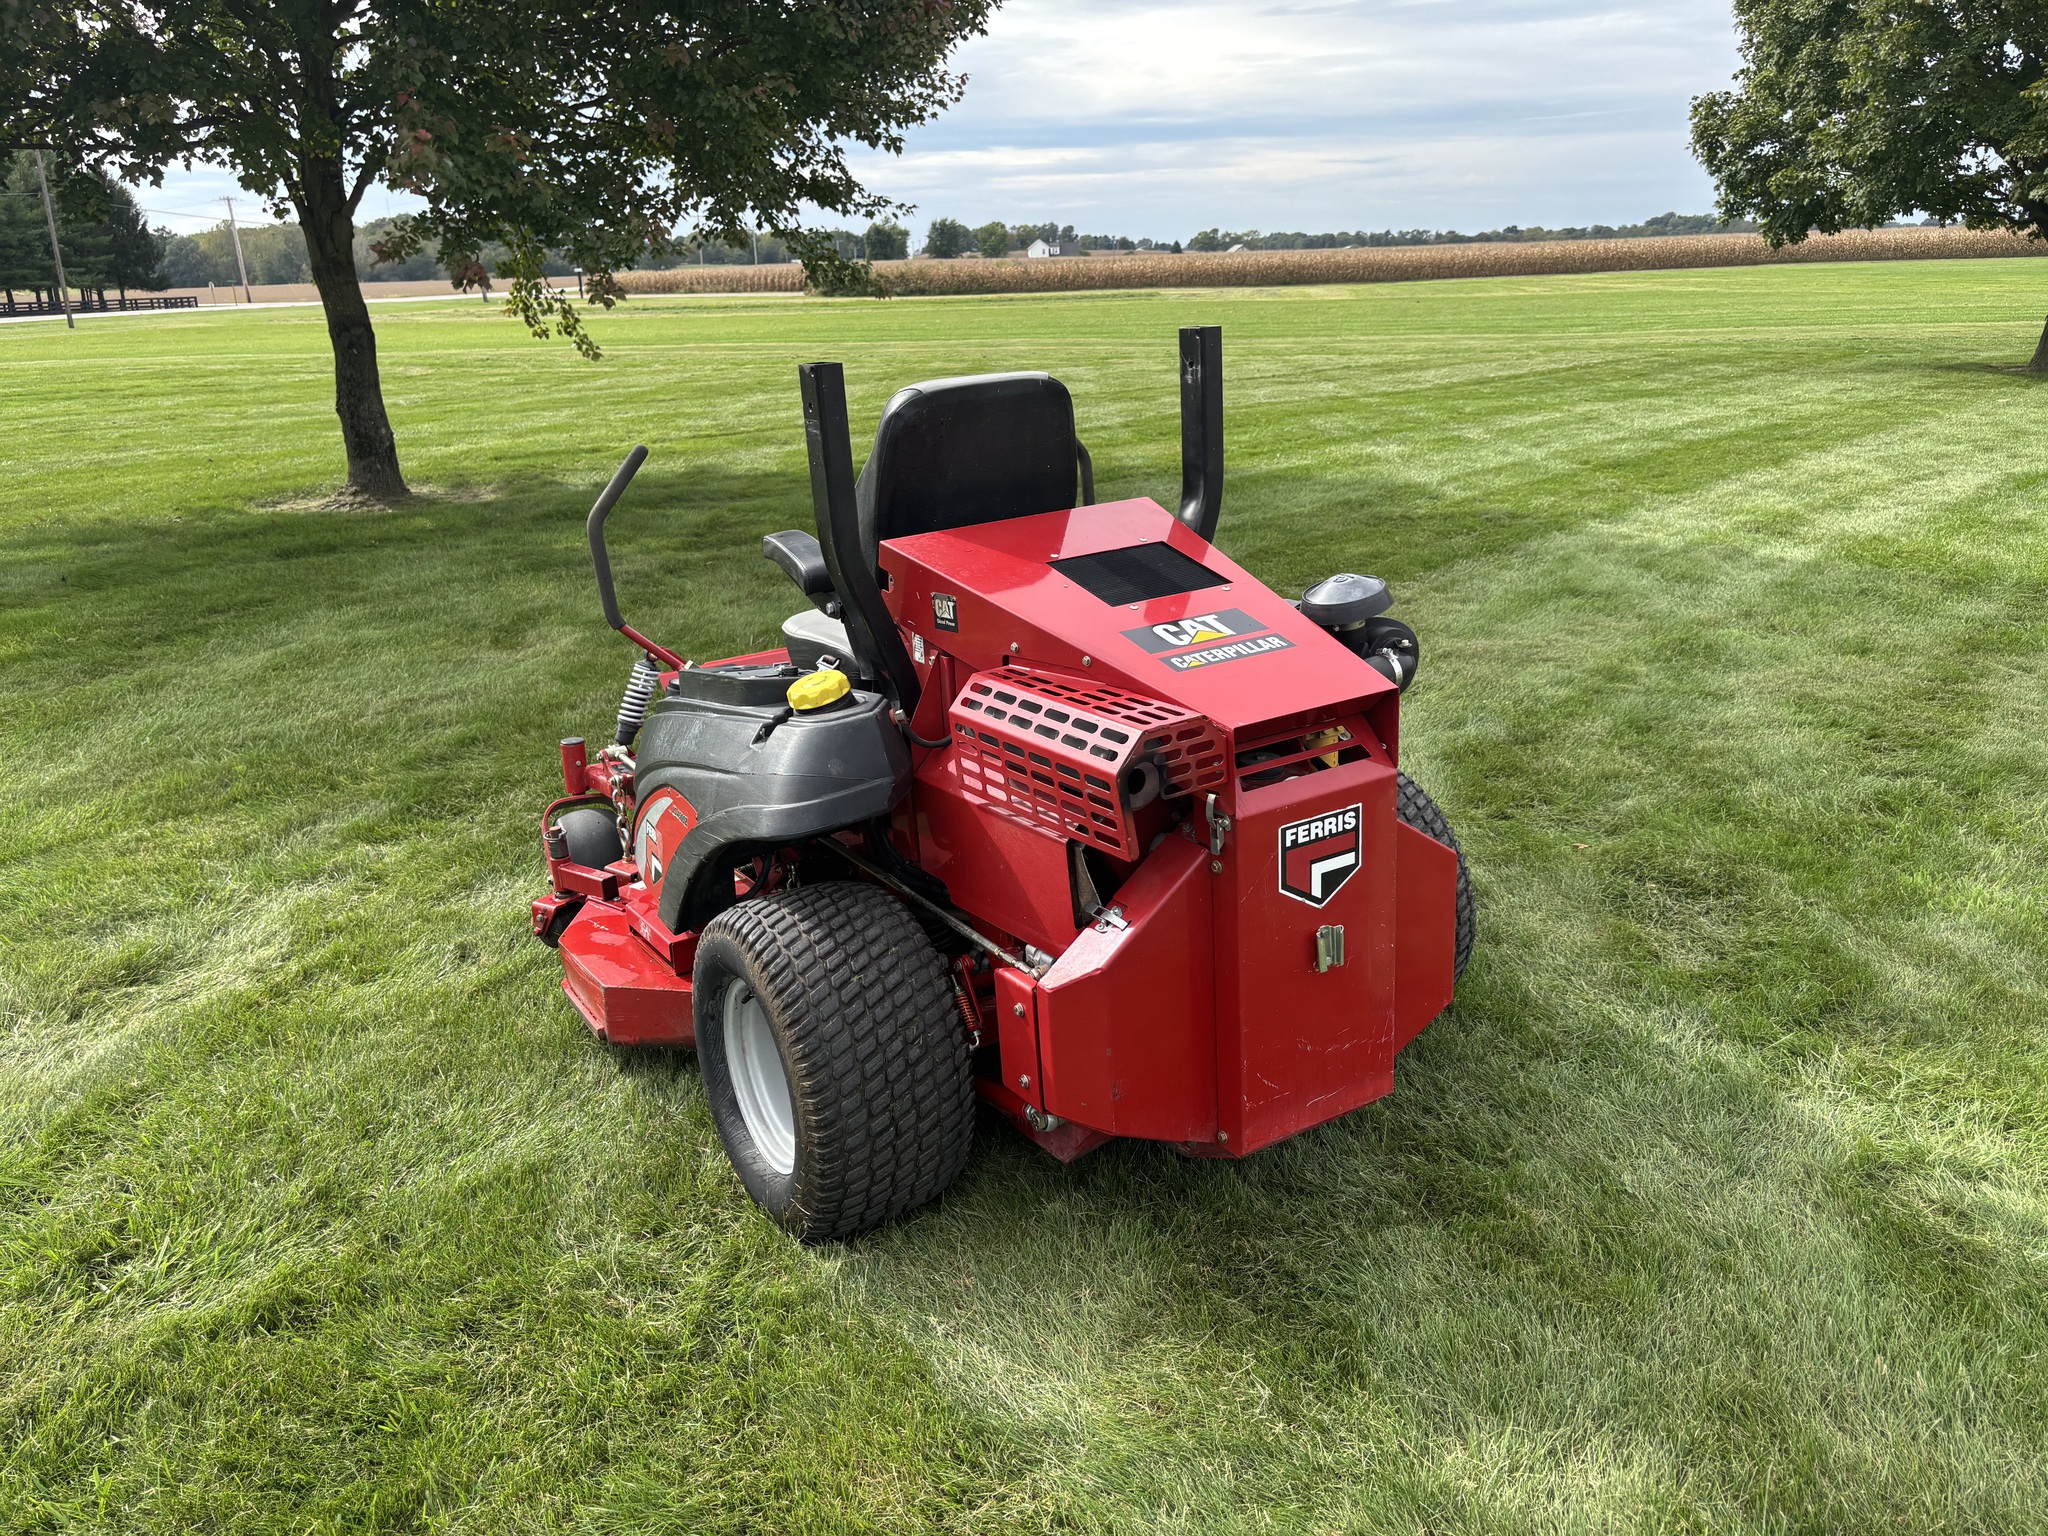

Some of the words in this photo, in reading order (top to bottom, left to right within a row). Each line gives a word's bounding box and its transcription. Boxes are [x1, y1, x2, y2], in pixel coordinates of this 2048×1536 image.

[934, 598, 955, 620] CAT
[1152, 614, 1237, 646] CAT
[1170, 636, 1288, 668] CATERPILLAR
[1285, 811, 1357, 848] FERRIS
